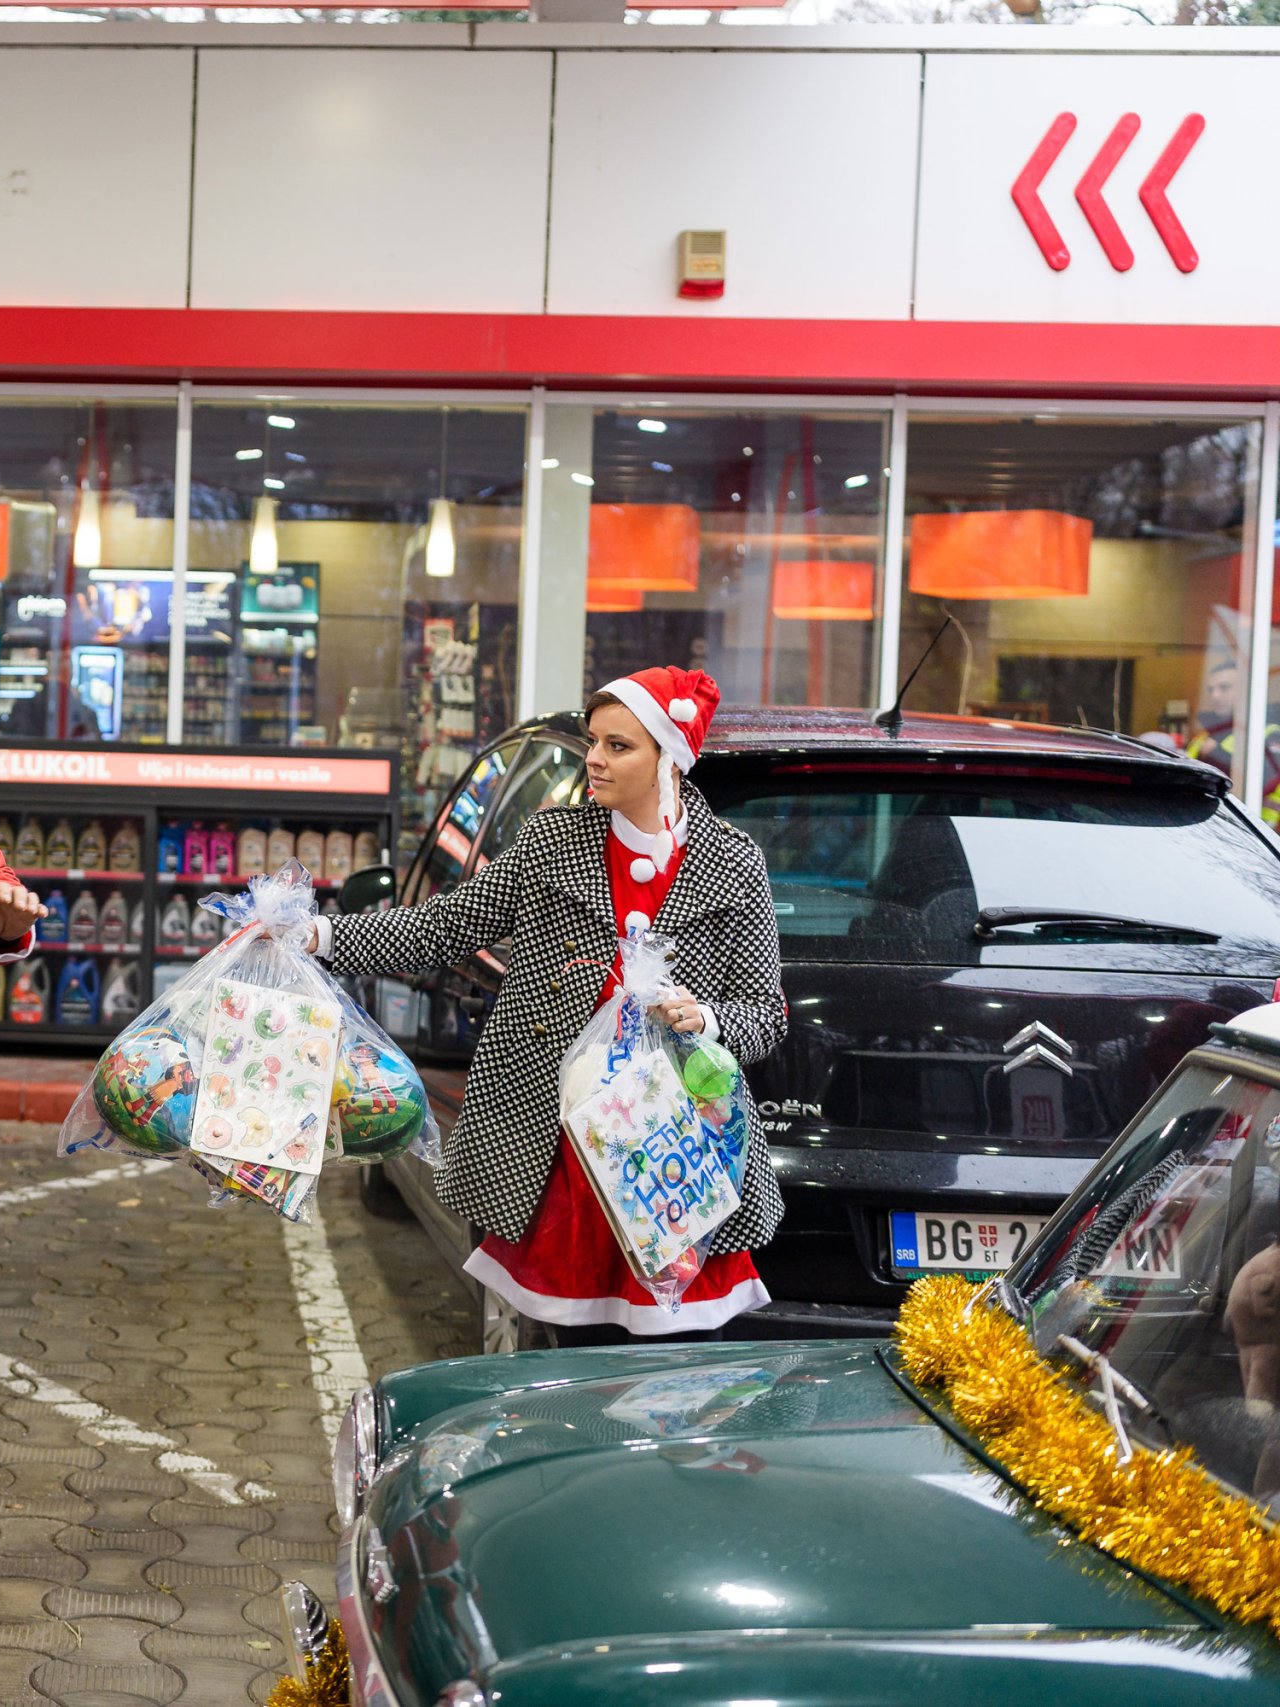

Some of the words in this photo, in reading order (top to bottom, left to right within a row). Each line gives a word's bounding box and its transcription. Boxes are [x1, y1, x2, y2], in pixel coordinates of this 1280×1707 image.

[11, 753, 111, 779] LUKOIL
[622, 1097, 696, 1184] СРЕЋНА
[634, 1123, 720, 1214] НОВА
[654, 1147, 733, 1236] ГОДИНА
[896, 1248, 916, 1260] SRB
[925, 1219, 973, 1262] BG
